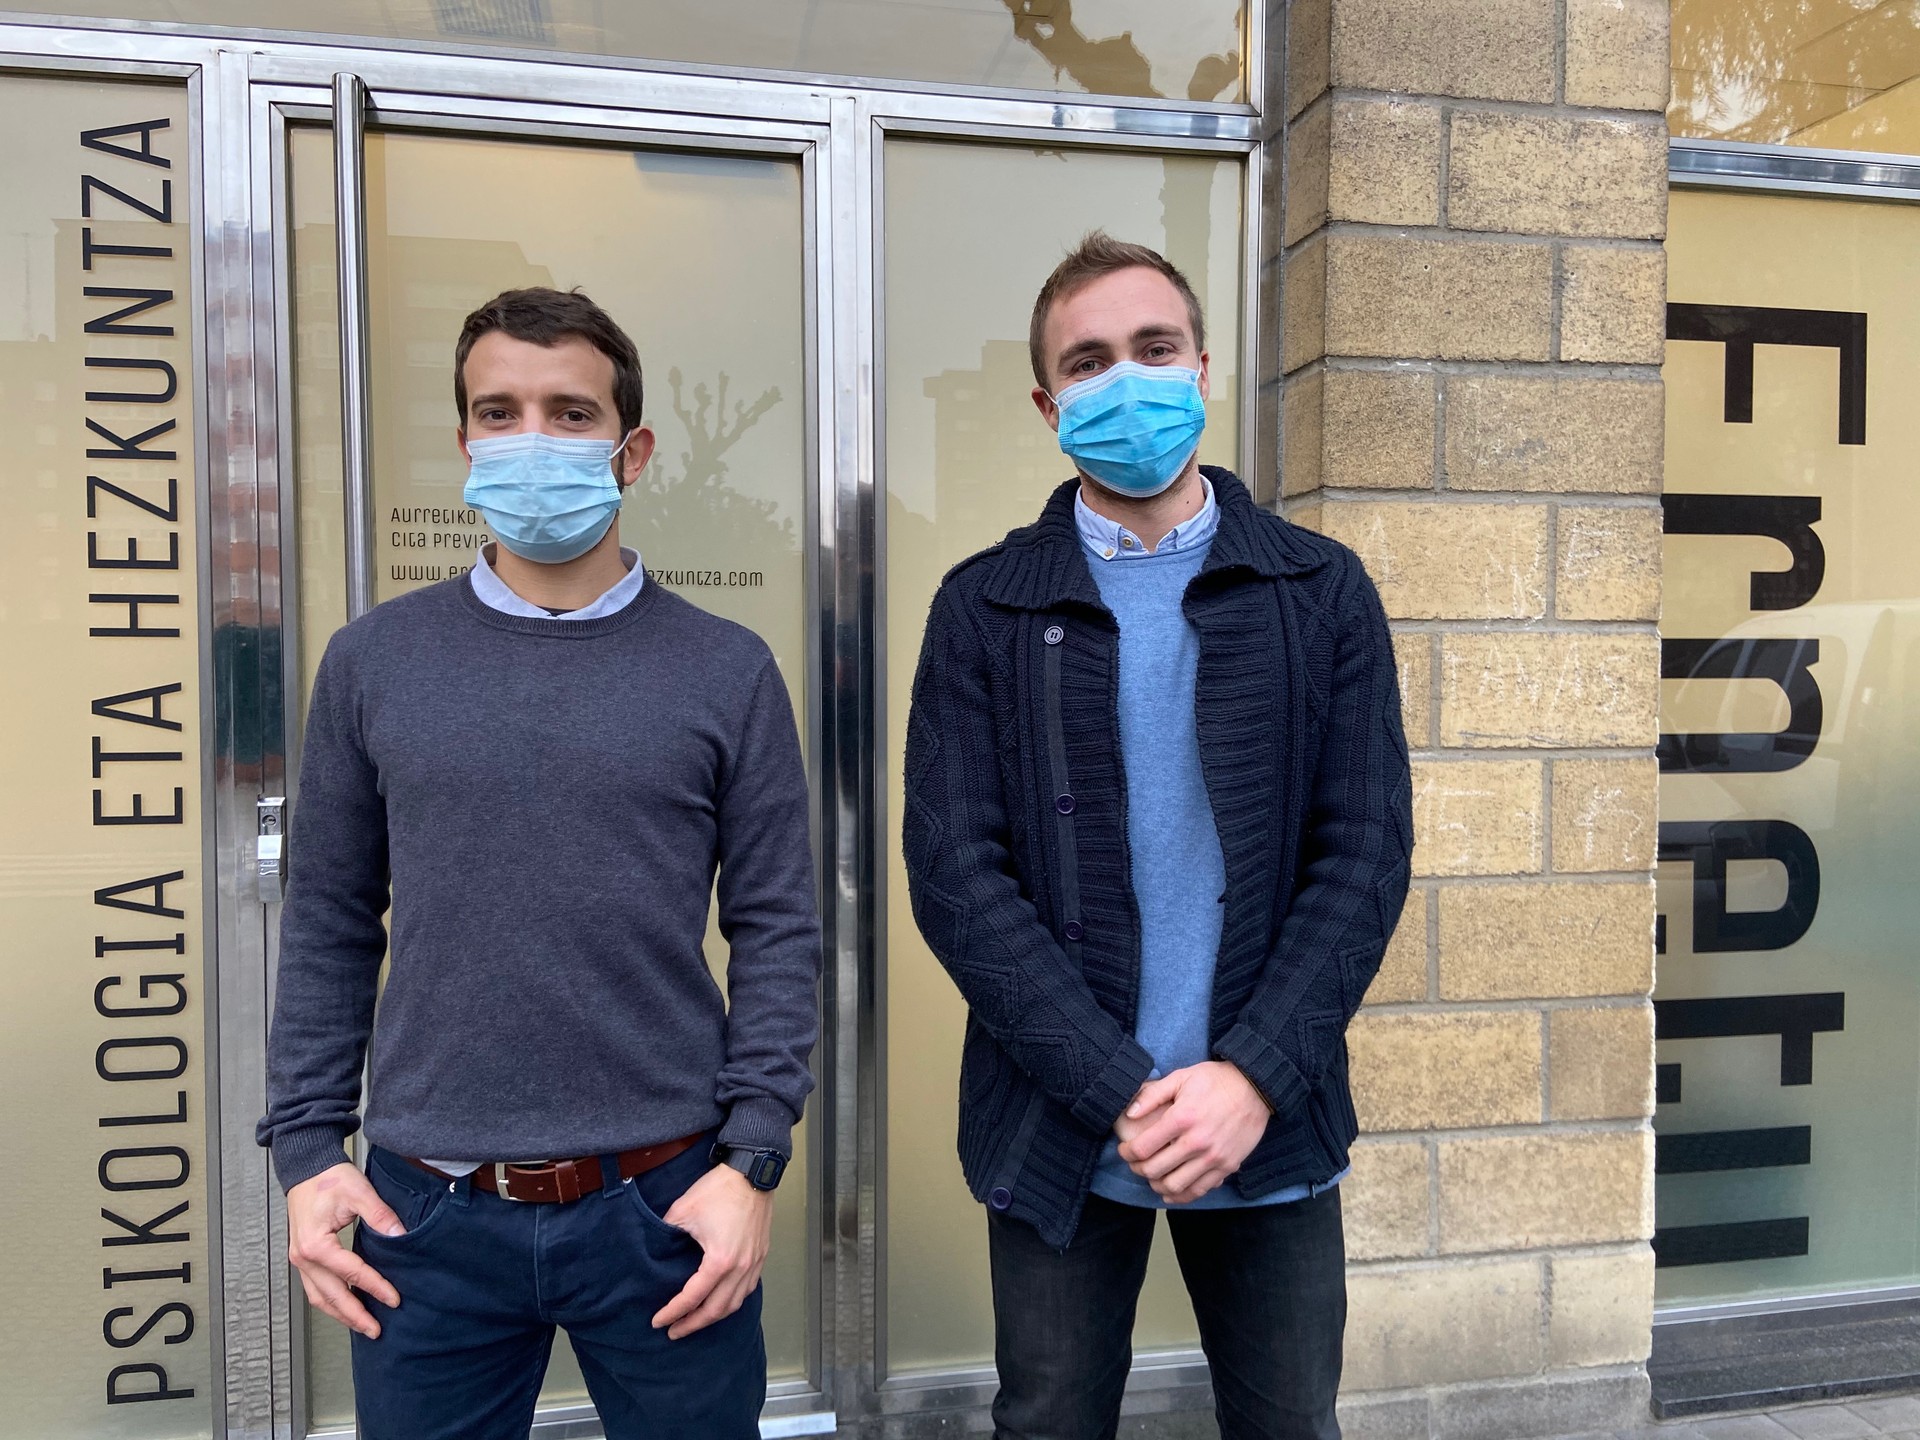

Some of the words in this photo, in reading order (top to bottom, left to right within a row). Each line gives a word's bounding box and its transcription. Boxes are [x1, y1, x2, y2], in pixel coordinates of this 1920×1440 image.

[80, 117, 180, 638] HEZKUNTZA
[390, 507, 476, 525] Aurretiko
[91, 682, 183, 826] ETA
[93, 870, 195, 1405] PSIKOLOGIA
